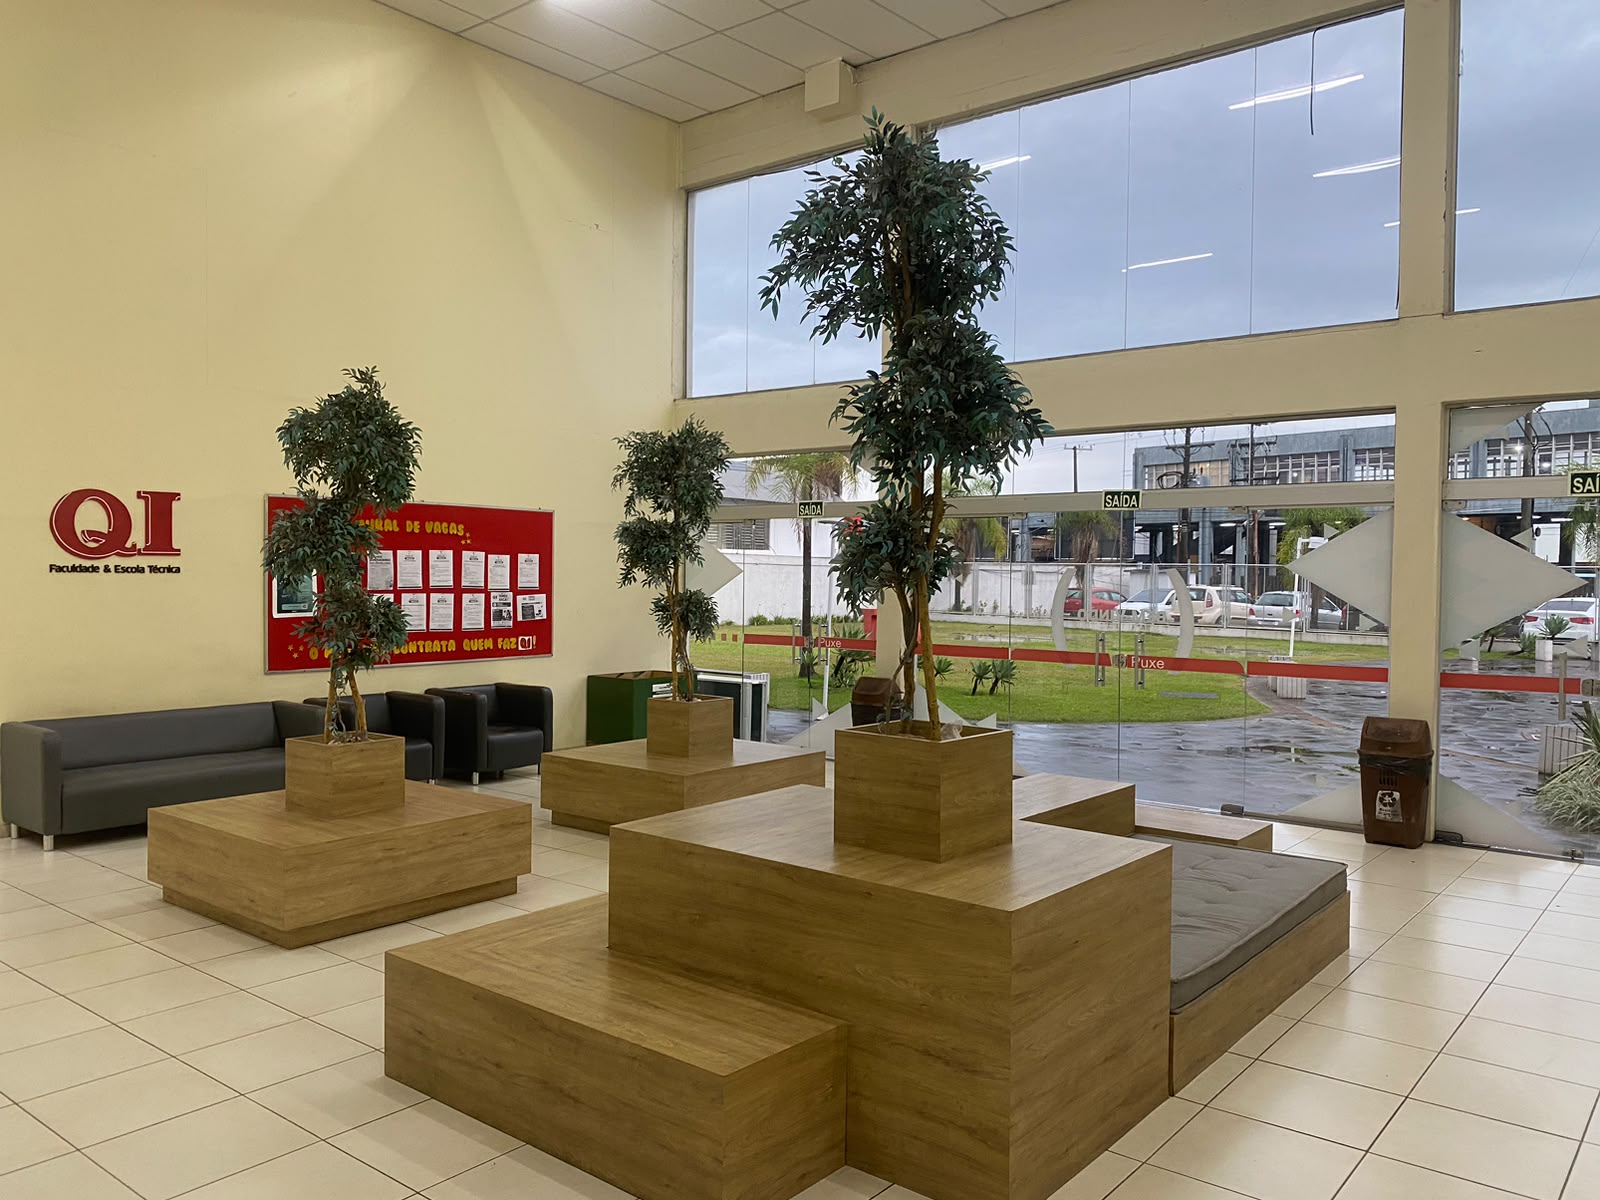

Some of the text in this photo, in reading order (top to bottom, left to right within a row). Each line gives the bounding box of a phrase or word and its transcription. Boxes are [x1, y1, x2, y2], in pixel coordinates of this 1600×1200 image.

[1105, 492, 1138, 507] SAÍDA
[799, 502, 822, 515] SAÍDA
[49, 488, 181, 560] QI
[406, 520, 420, 533] DE
[425, 521, 464, 536] VAGAS
[49, 564, 181, 574] Faculdade & Escola Técnica
[463, 638, 493, 651] QUEM
[497, 637, 516, 650] FAZ
[820, 637, 841, 648] Puxe
[1131, 656, 1165, 669] Puxe
